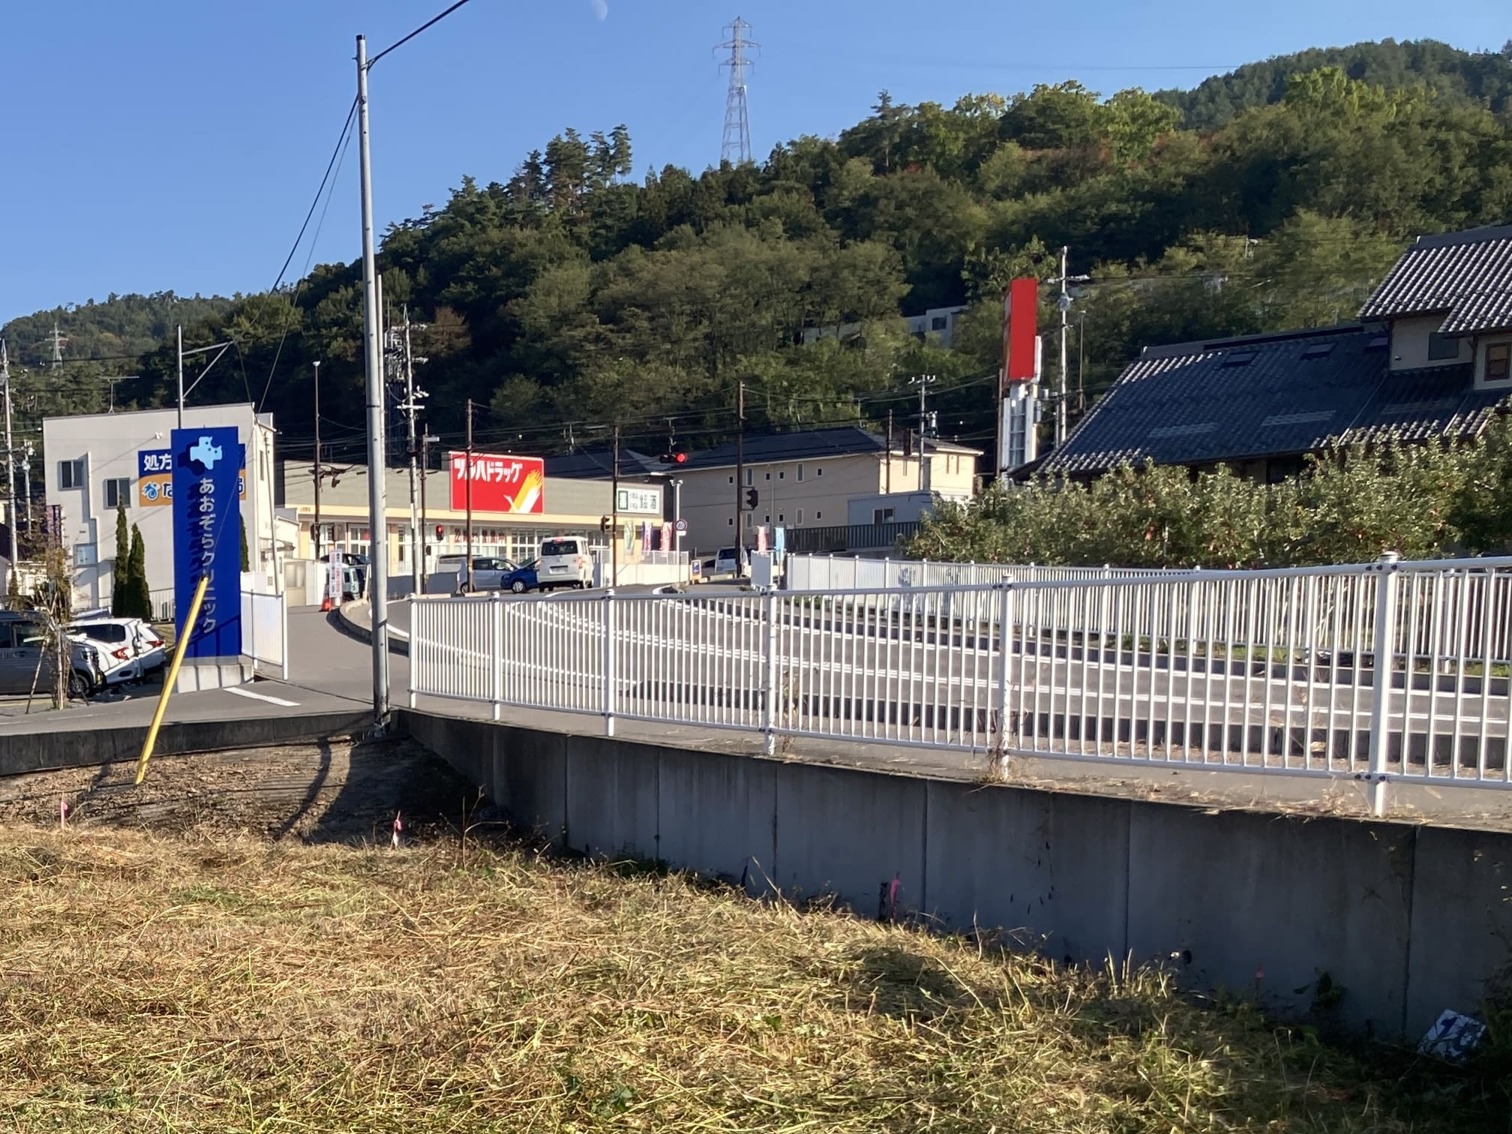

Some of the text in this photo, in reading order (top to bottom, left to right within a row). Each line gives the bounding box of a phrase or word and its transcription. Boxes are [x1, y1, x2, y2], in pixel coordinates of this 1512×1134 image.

[199, 477, 217, 633] あおぞらクリニック
